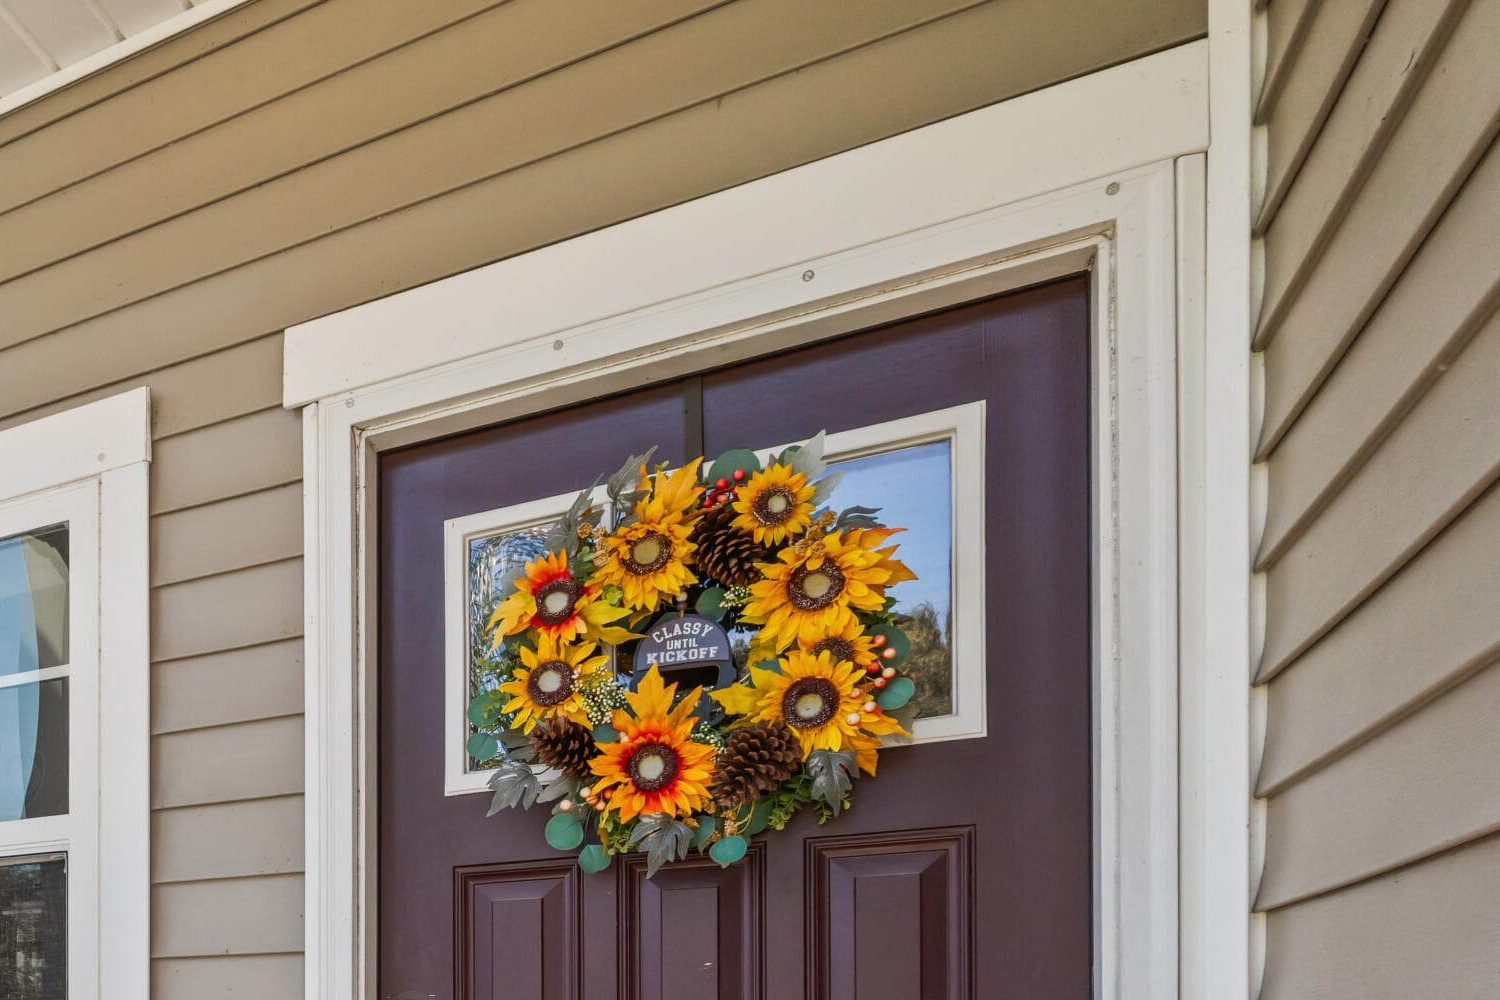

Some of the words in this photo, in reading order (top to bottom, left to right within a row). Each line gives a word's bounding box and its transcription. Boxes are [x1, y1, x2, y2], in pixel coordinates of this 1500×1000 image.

[652, 622, 714, 644] CLASSY
[666, 638, 699, 650] UNTIL
[646, 646, 719, 664] KICKOFF
